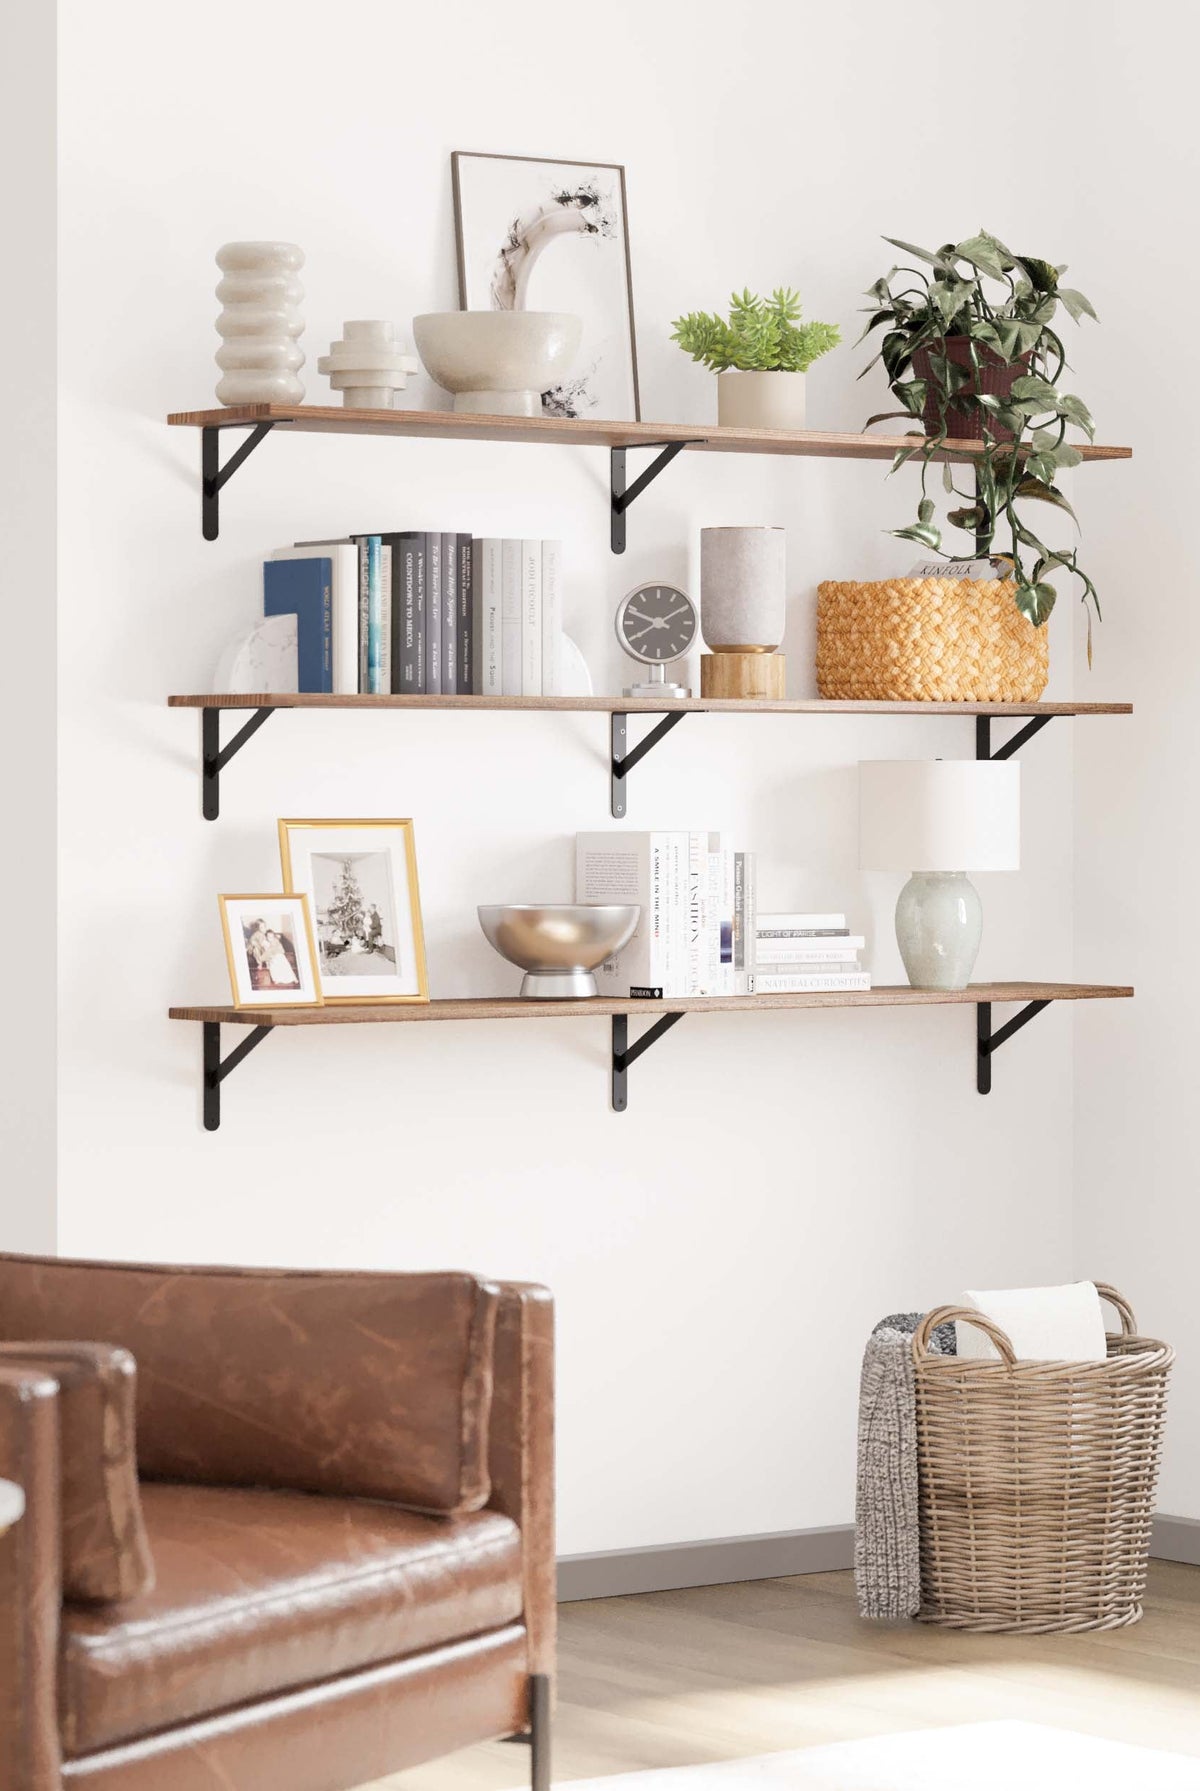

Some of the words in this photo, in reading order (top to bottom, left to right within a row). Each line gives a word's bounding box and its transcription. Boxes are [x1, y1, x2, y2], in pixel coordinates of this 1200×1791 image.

[361, 545, 369, 564] THE
[432, 545, 439, 555] To
[432, 555, 439, 566] Be
[528, 556, 536, 580] JODI
[920, 564, 974, 576] KINFOLK
[361, 566, 369, 595] LIGHT
[446, 576, 455, 596] Holly
[361, 596, 369, 612] OF
[406, 606, 413, 618] TO
[446, 597, 454, 628] Springs
[528, 582, 536, 627] PICOULT
[708, 856, 720, 892] Elliott
[735, 860, 743, 886] Picasso
[654, 884, 660, 894] IN
[735, 886, 743, 912] Guitars
[690, 873, 699, 943] FASHION
[708, 895, 720, 931] Erwitt
[706, 935, 720, 980] Snaps
[765, 978, 807, 988] NATURAL
[808, 976, 868, 987] CURIOSITIES
